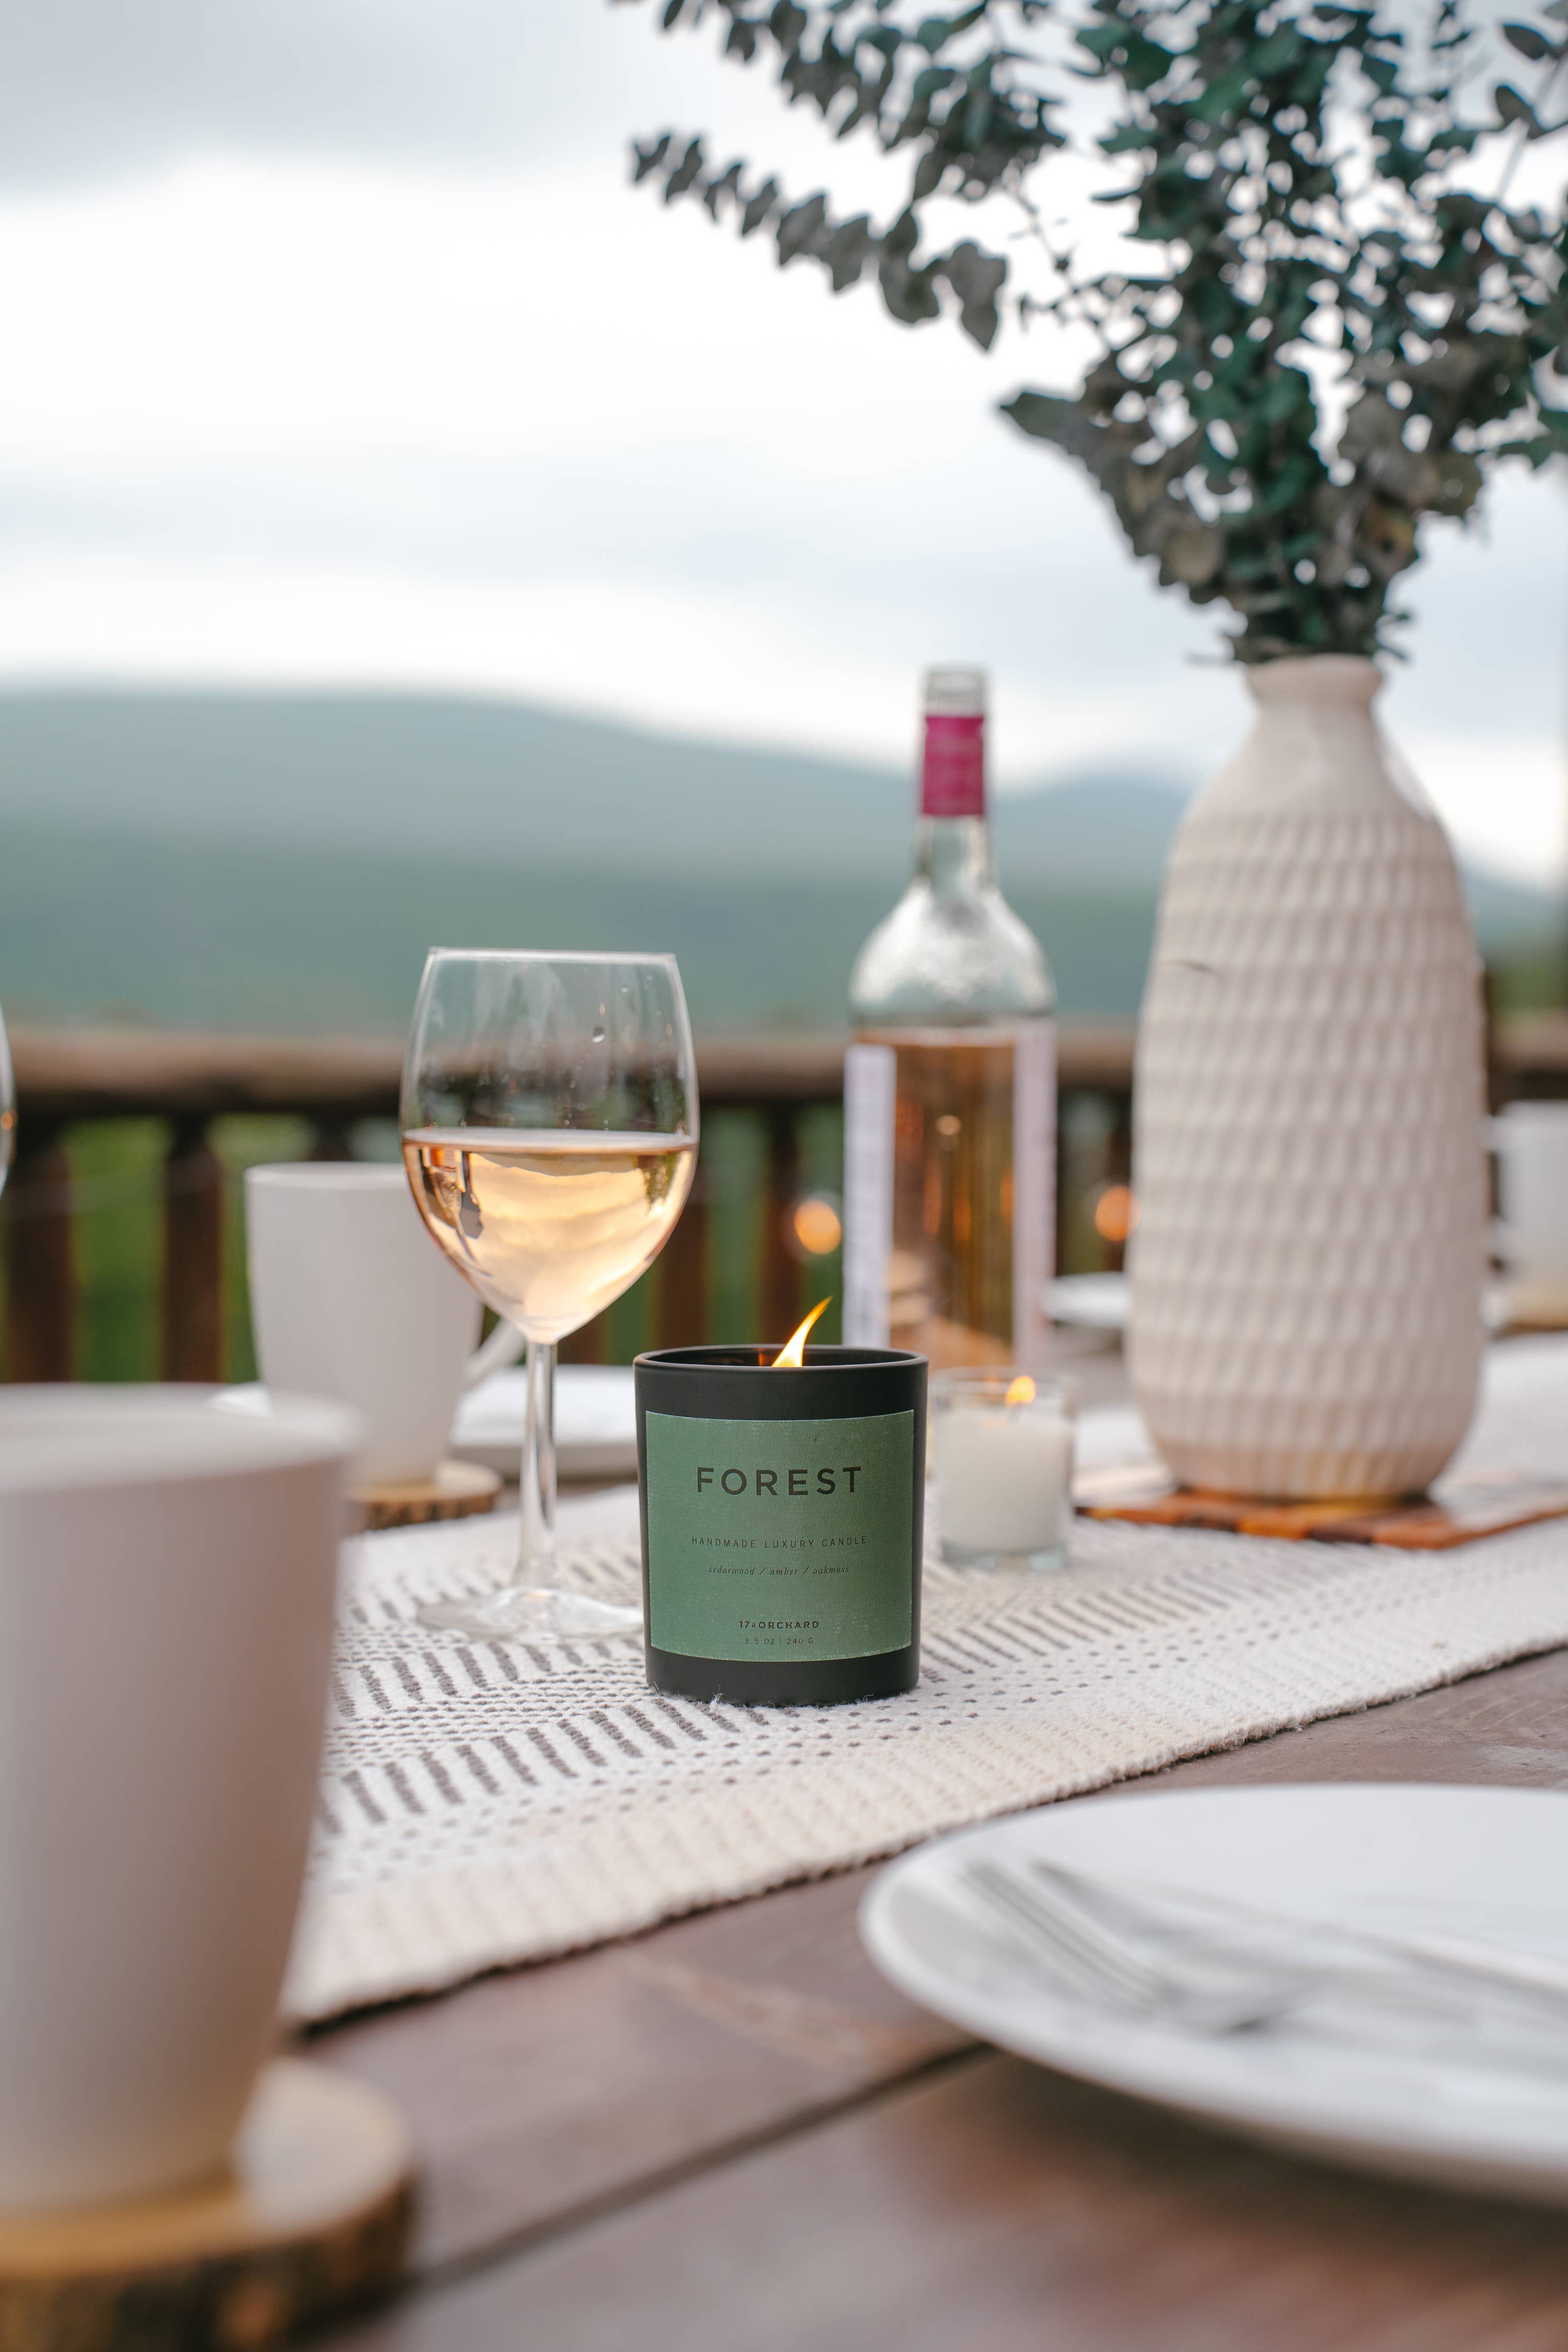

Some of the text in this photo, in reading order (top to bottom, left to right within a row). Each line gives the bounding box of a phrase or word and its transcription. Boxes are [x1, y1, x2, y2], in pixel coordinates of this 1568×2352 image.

[697, 1466, 861, 1496] FOREST
[692, 1536, 867, 1548] HANDMADE LUXURY CANDLE
[709, 1565, 755, 1575] cedarwood
[770, 1567, 798, 1575] amber
[813, 1566, 849, 1575] oakmoss
